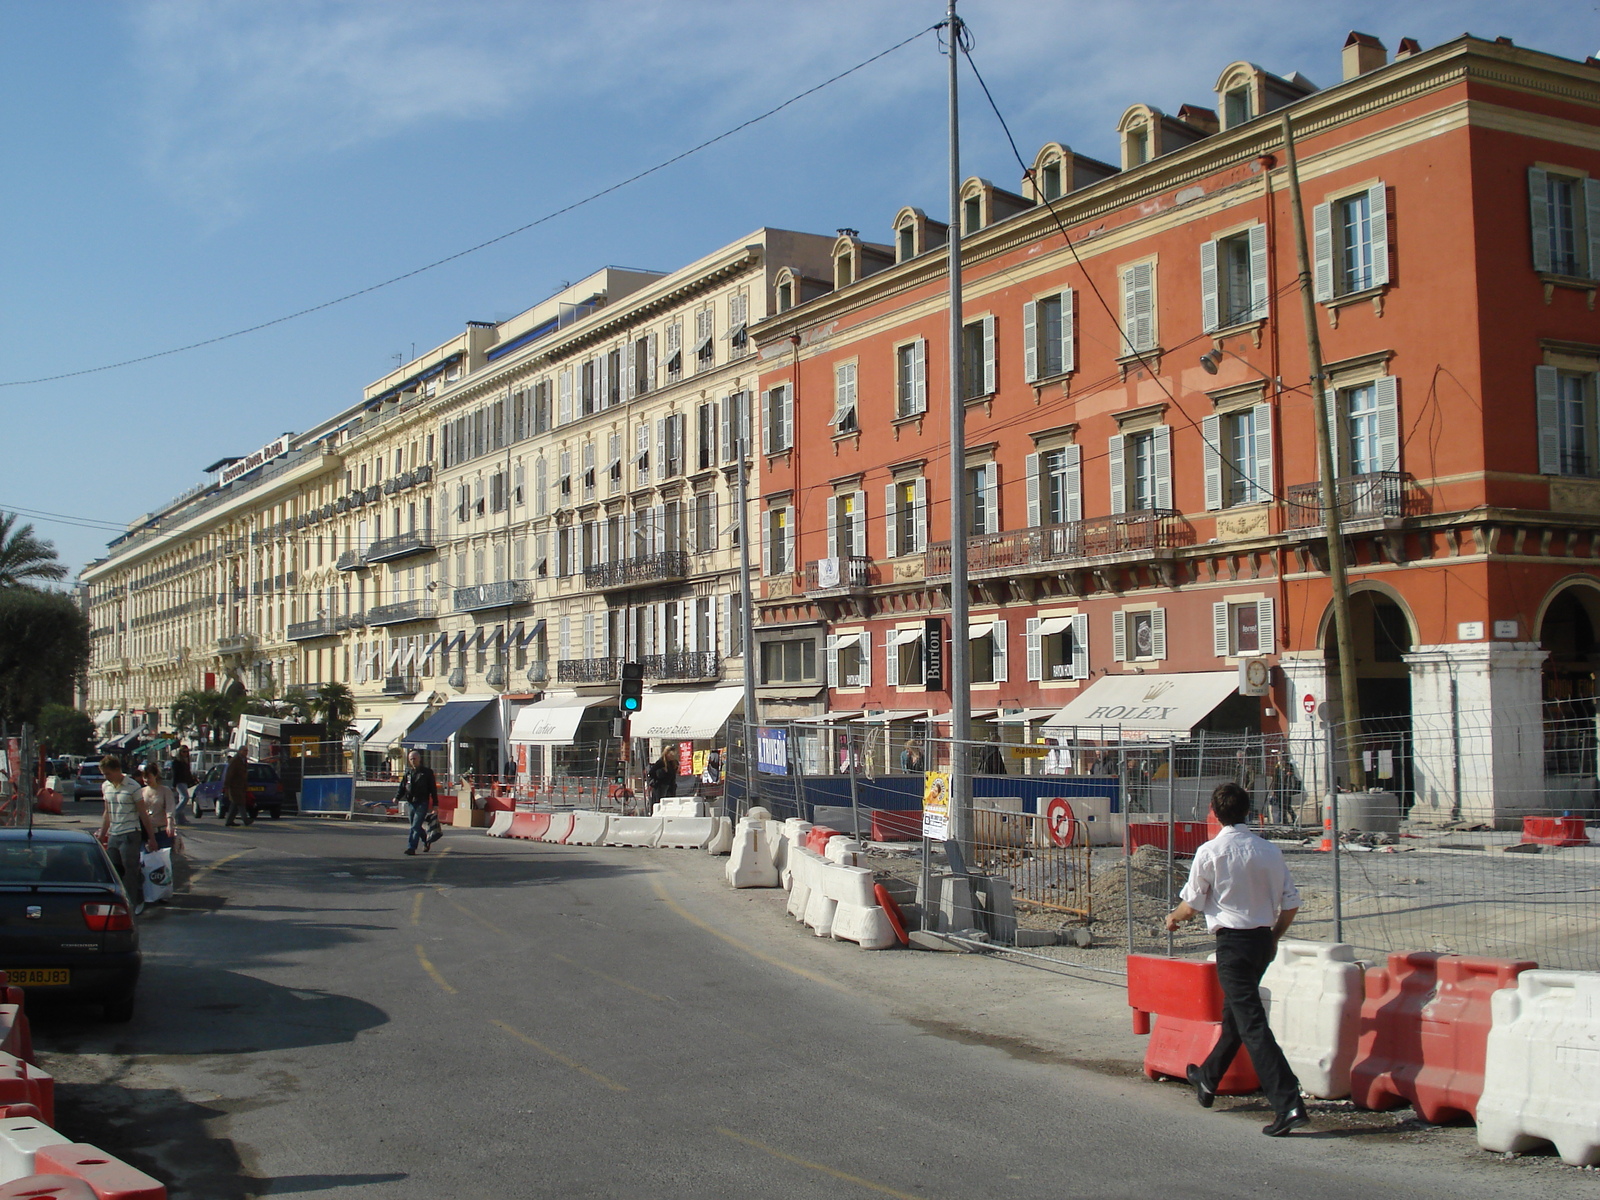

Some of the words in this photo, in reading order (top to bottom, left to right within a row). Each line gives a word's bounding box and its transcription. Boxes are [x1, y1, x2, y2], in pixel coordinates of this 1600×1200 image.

[245, 452, 263, 471] HOTEL
[264, 441, 283, 461] PLAZA
[927, 630, 941, 680] Burton
[1085, 705, 1179, 720] ROLEX
[532, 719, 556, 735] Cartier
[150, 871, 165, 881] City
